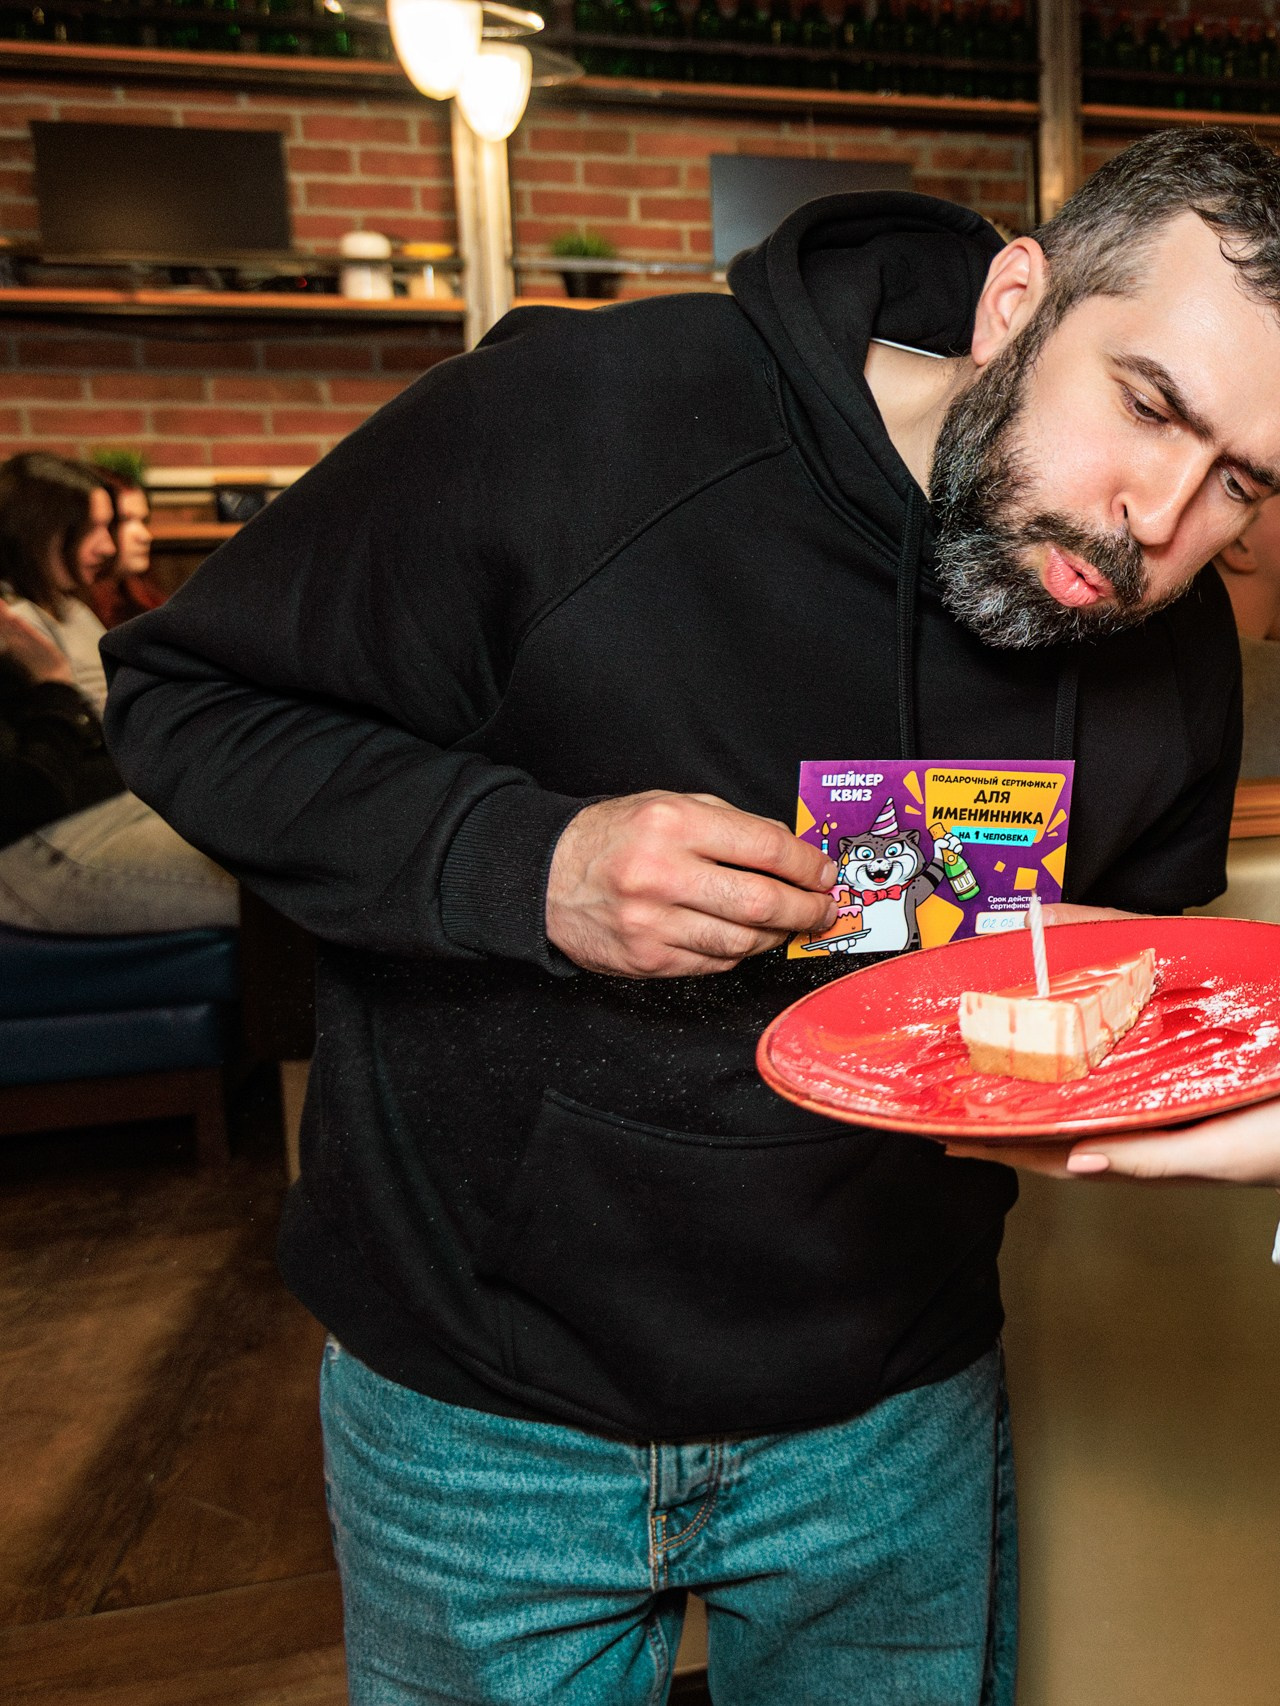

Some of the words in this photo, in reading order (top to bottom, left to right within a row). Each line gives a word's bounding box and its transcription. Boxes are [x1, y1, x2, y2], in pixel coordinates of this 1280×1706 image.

[822, 770, 884, 787] ШЕЙКЕР
[932, 774, 999, 786] ПОДАРОЧНЫЙ
[1001, 778, 1058, 790] СЕРТИФИКАТ
[830, 788, 873, 802] КВИЗ
[973, 789, 1011, 804] ДЛЯ
[932, 806, 1044, 825] ИМЕНИННИКА
[958, 831, 971, 840] НА
[974, 830, 980, 840] 1
[983, 833, 1029, 842] ЧЕЛОВЕКА
[987, 895, 1007, 904] Срок
[1008, 894, 1042, 904] действя
[990, 903, 1030, 911] сертифика
